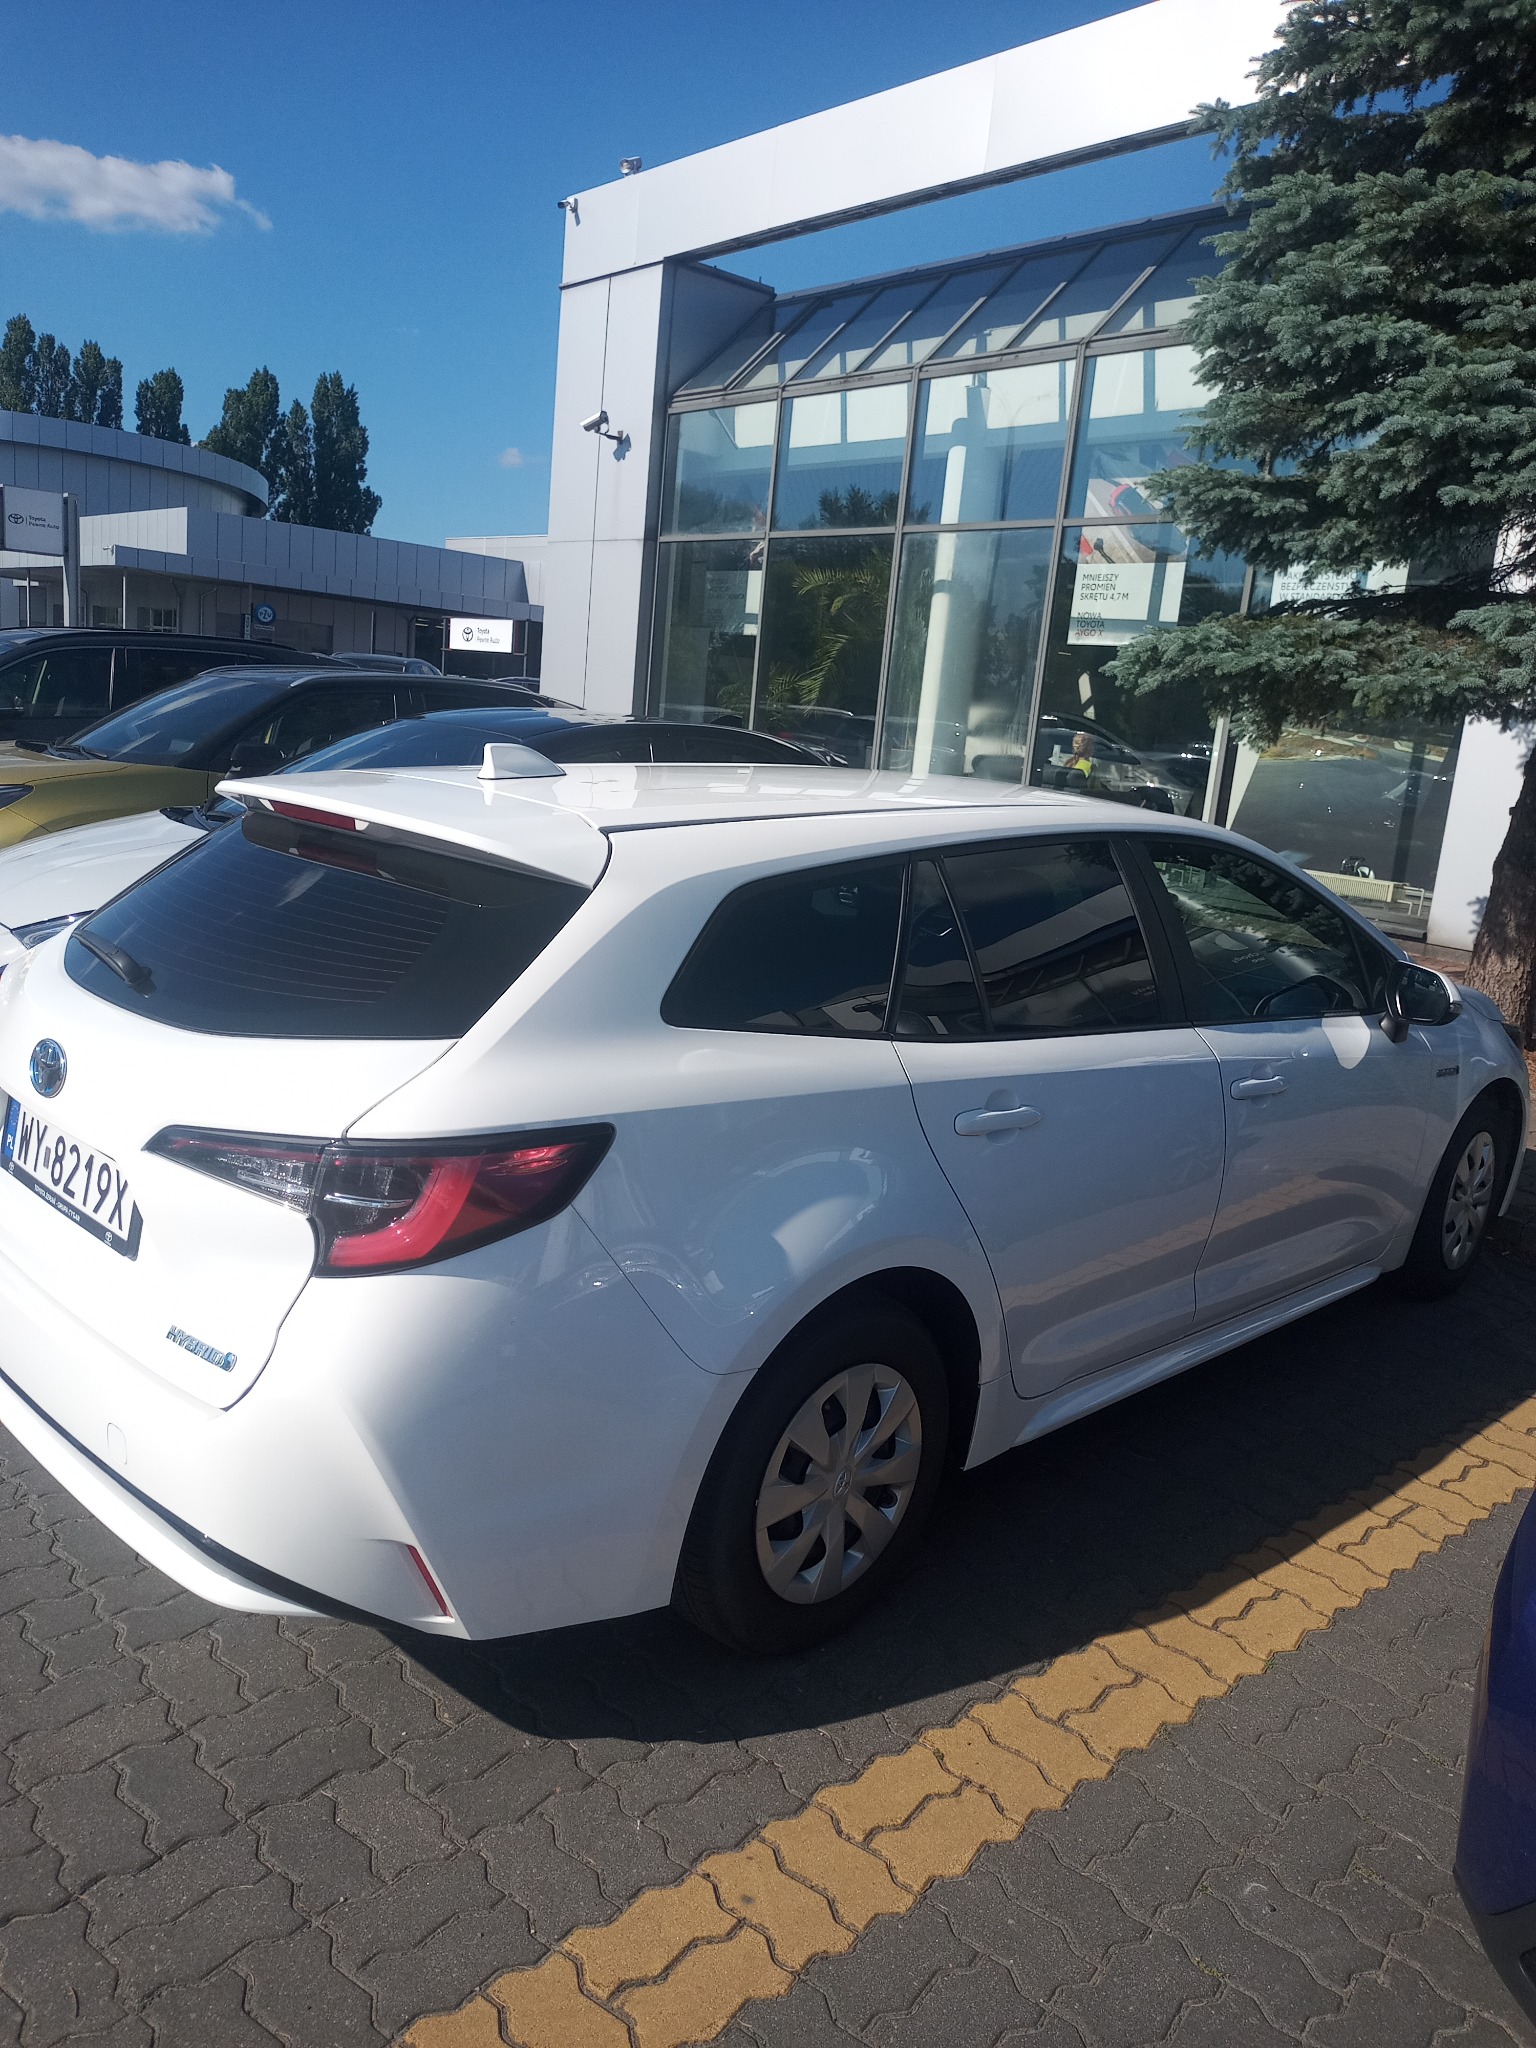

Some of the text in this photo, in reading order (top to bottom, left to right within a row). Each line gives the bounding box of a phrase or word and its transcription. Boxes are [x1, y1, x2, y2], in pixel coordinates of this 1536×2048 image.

[1082, 573, 1119, 581] MNIEJSZY
[1080, 592, 1108, 602] SKRĘTU
[259, 608, 272, 620] PZU
[1077, 611, 1101, 619] NOWA
[1076, 620, 1104, 628] TOYOTA
[477, 627, 490, 635] Toyota
[1075, 628, 1096, 637] AYGO
[7, 1133, 14, 1149] PL
[166, 1324, 226, 1369] HYBRID
